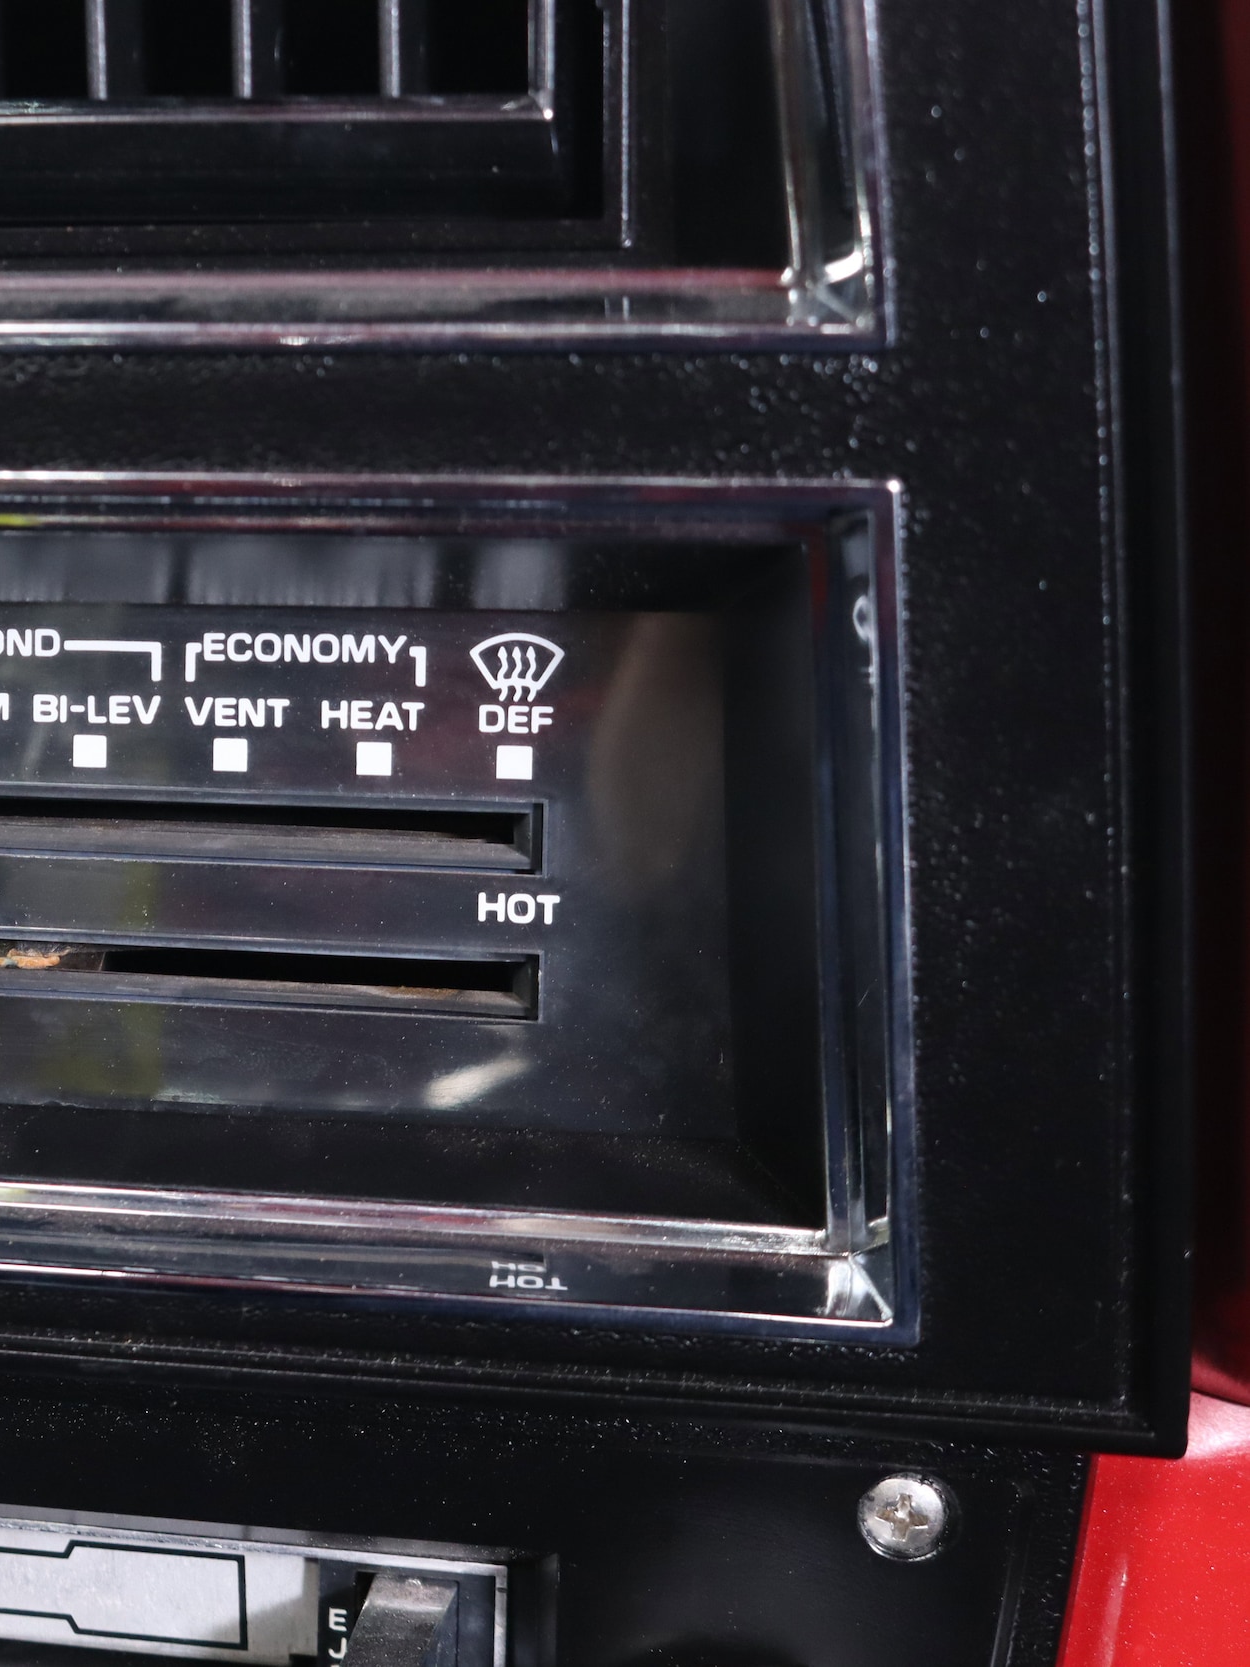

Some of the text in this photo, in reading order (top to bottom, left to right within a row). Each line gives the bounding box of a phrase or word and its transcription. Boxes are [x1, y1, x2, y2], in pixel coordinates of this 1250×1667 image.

[201, 631, 408, 665] ECONOMY
[31, 693, 162, 725] BI-LEV
[183, 696, 291, 729] VENT
[320, 699, 425, 732] HEAT
[477, 703, 555, 735] DEF
[476, 891, 562, 926] HOT
